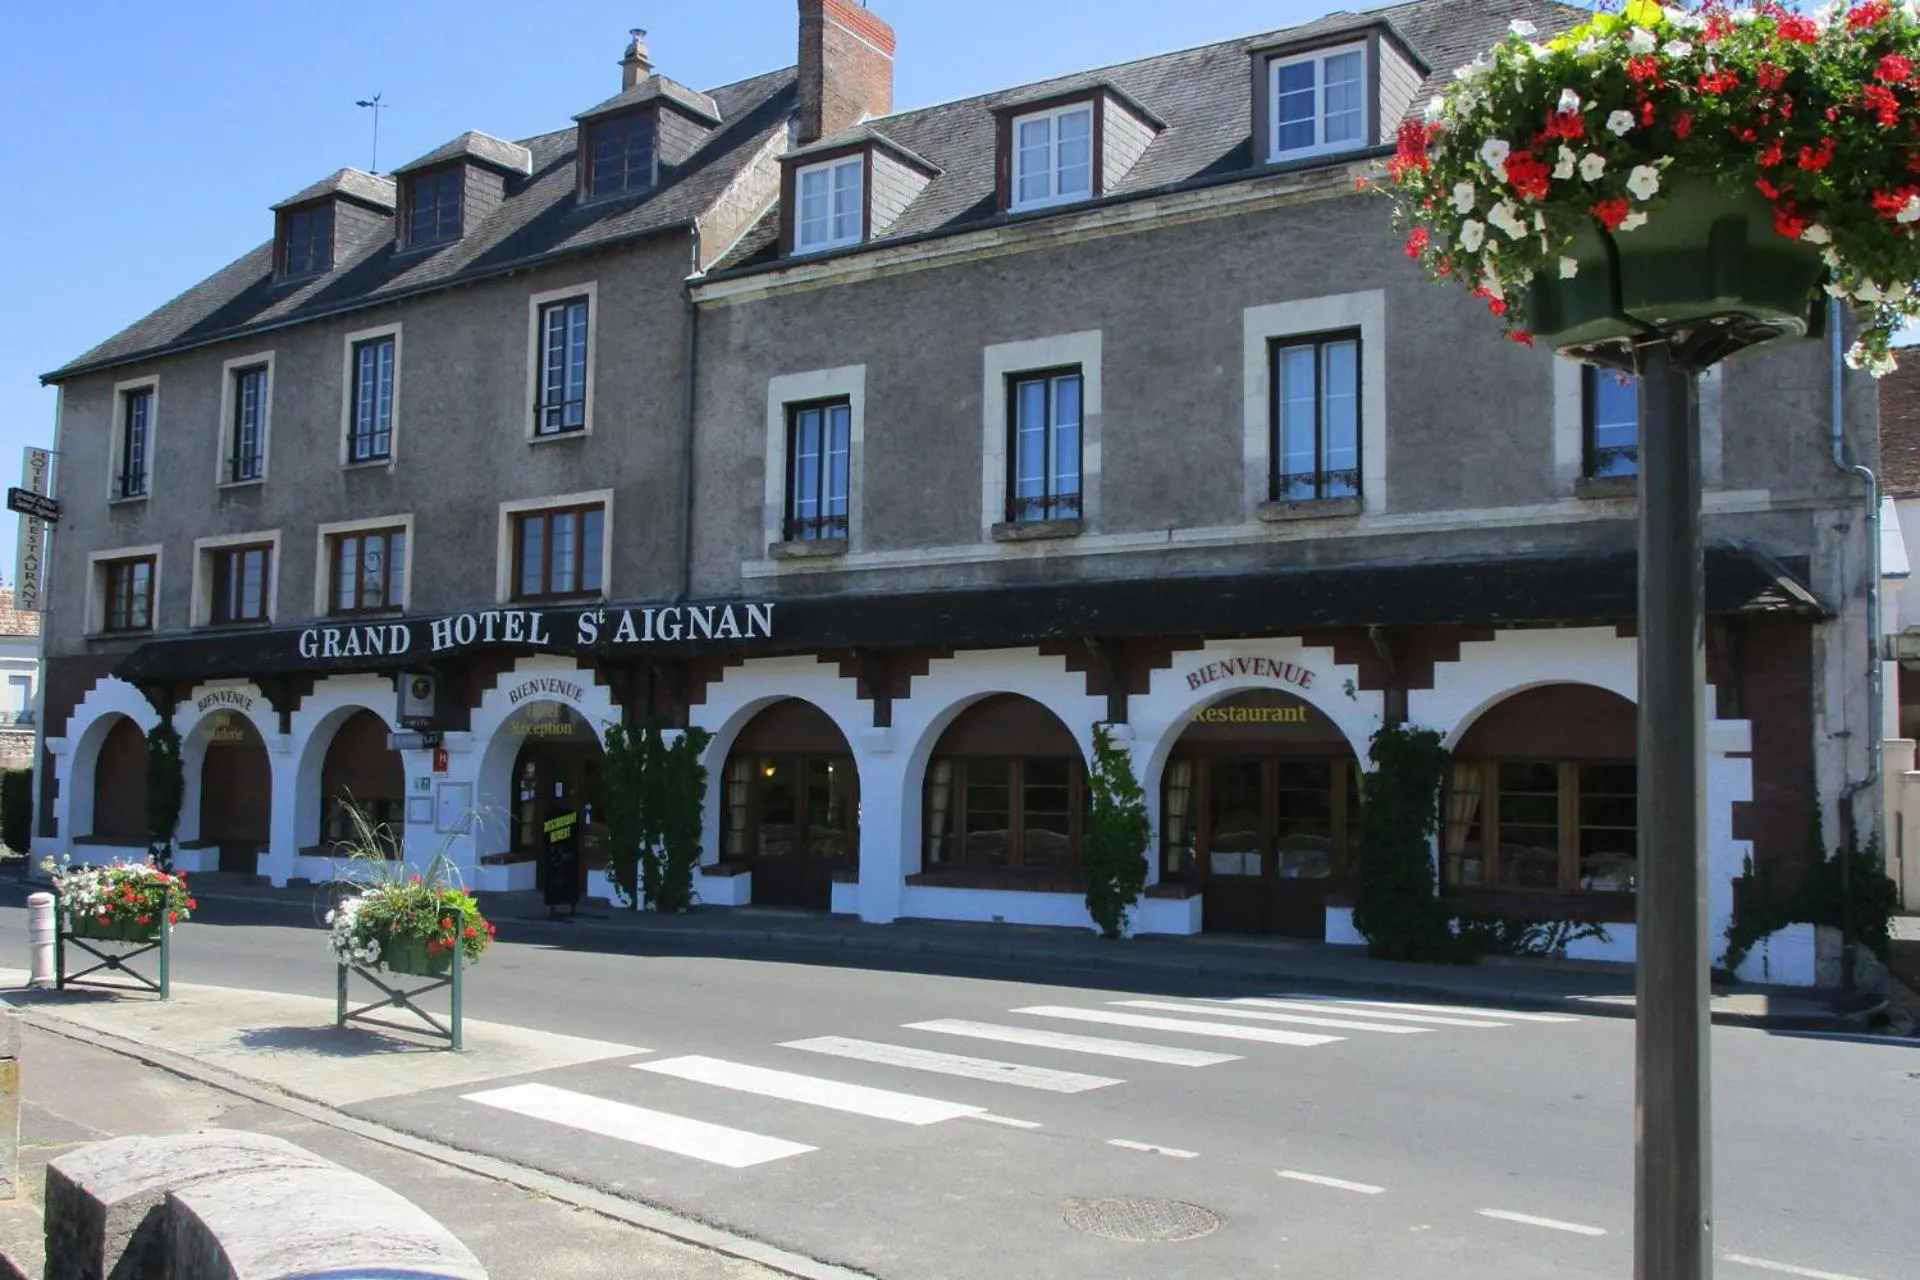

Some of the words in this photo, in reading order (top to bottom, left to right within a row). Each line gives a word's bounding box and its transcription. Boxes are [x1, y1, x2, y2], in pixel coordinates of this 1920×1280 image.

[22, 516, 39, 608] RESTAURANT
[299, 624, 411, 659] GRAND
[430, 611, 549, 651] HOTEL
[577, 608, 606, 644] St
[613, 603, 775, 643] AIGNAN
[1186, 657, 1316, 691] BIENVENUE
[197, 690, 254, 712] BIENVENUE
[508, 677, 584, 705] BIENVENUE
[1191, 704, 1306, 723] Restaurant
